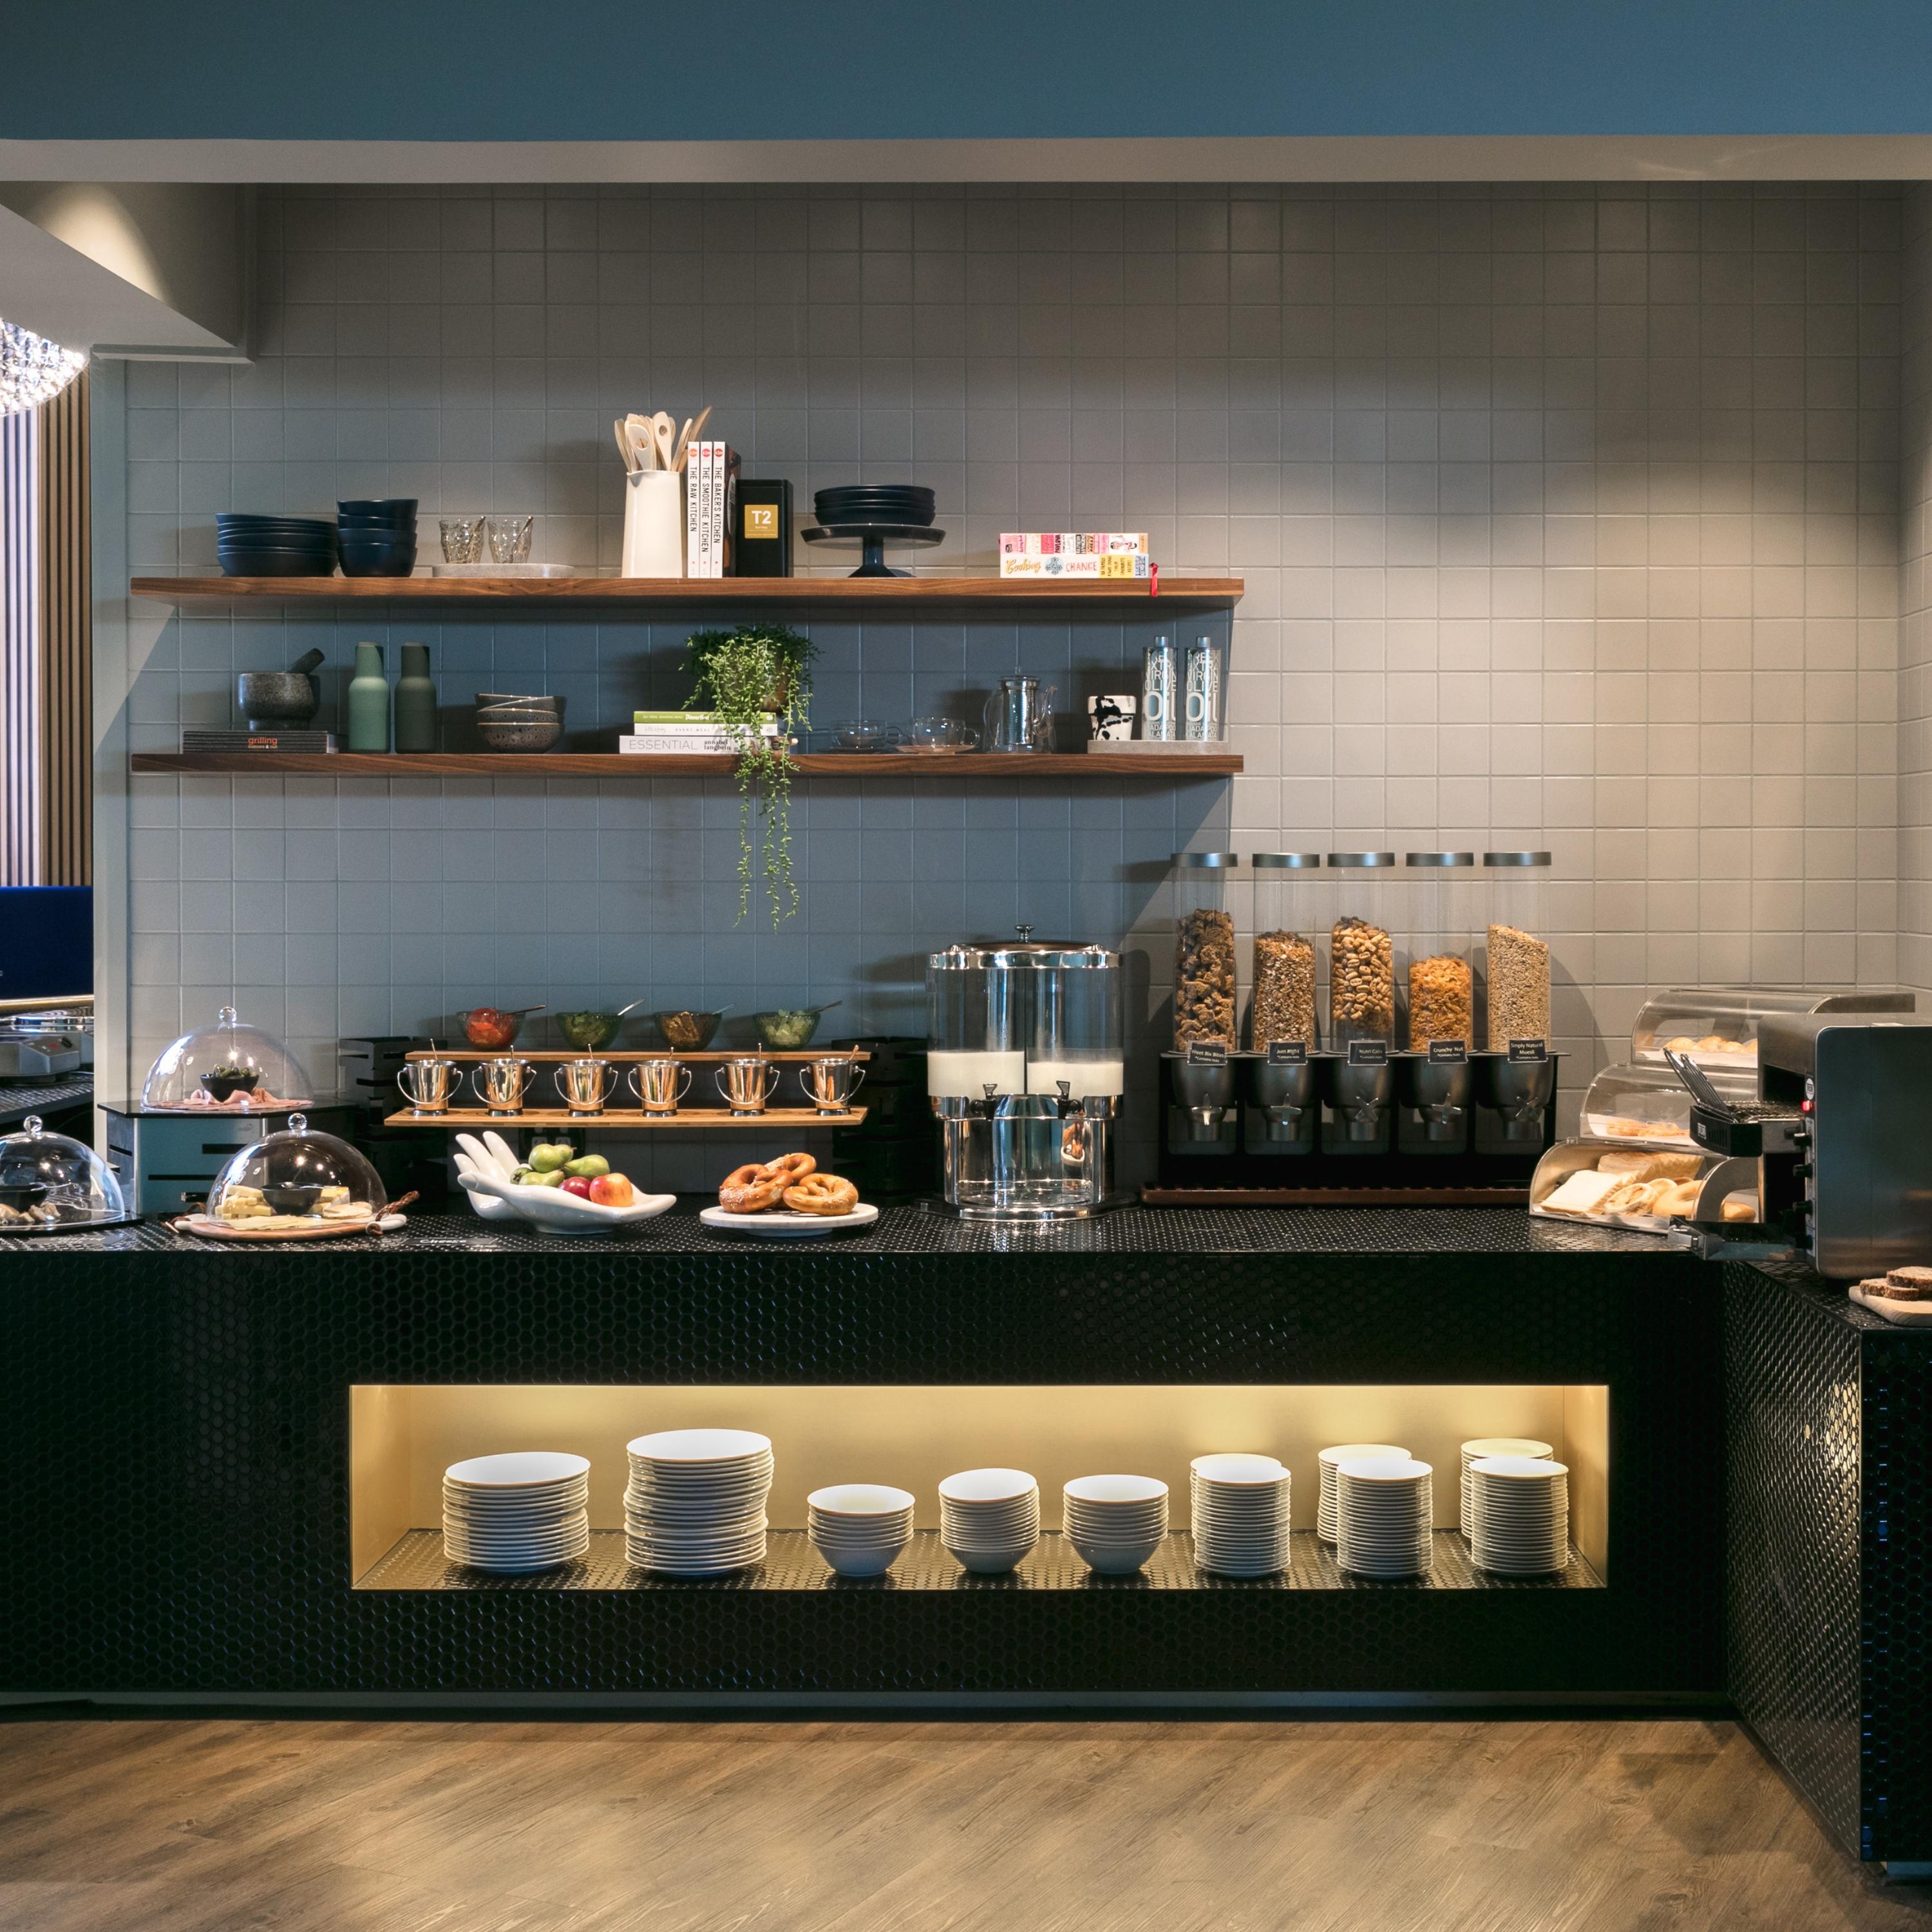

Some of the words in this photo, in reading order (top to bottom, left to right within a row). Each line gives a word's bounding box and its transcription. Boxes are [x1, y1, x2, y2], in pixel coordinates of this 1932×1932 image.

[702, 467, 710, 479] THE
[714, 467, 723, 479] THE
[702, 483, 710, 518] SMOOTHIE
[751, 510, 772, 524] T2
[713, 514, 721, 544] KITCHEN
[701, 522, 710, 553] KITCHEN
[1006, 558, 1042, 574] Cooking
[1066, 561, 1098, 573] CHANGE
[1144, 679, 1177, 691] OLIVE
[1186, 680, 1218, 692] OLIVE
[247, 737, 278, 745] grilling
[629, 739, 697, 750] ESSENTIAL
